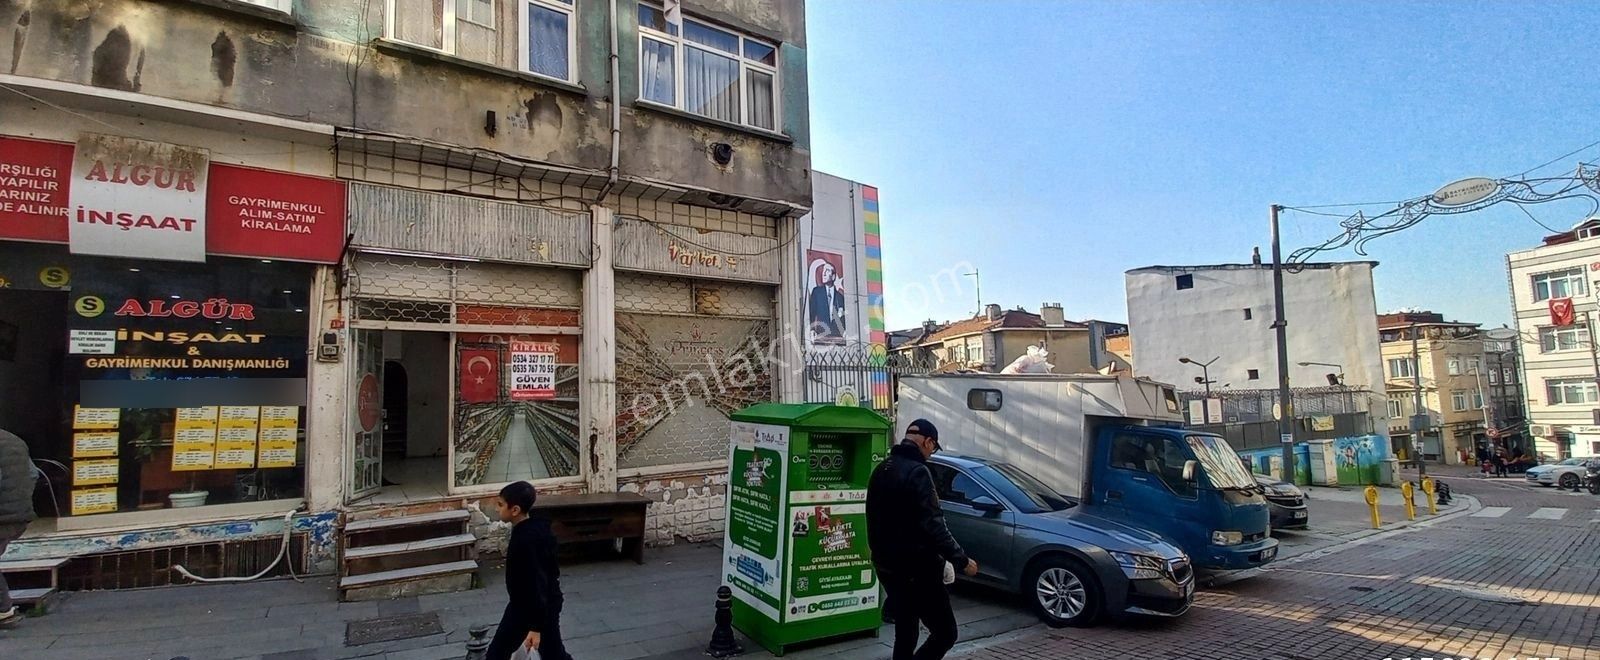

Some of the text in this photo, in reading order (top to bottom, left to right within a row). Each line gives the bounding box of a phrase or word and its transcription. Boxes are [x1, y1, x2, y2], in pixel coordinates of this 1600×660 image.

[85, 157, 196, 192] ALGÜR
[0, 176, 59, 191] YAPILIR
[0, 189, 50, 202] ARINIZ
[17, 204, 70, 216] ALINIR
[228, 196, 326, 214] GAYRİMENKUL
[76, 205, 197, 232] İNŞAAT
[239, 208, 316, 224] ALIM-SATIM
[242, 218, 312, 234] KİRALAMA
[114, 298, 255, 320] ALGÜR
[117, 328, 266, 345] İNŞAAT
[187, 346, 200, 356] &
[513, 354, 527, 363] 0534
[529, 354, 538, 363] 327
[86, 356, 289, 371] GAYRİMENKUL DANIŞMANLIĞI
[513, 364, 527, 373] 0535
[547, 365, 554, 373] 55
